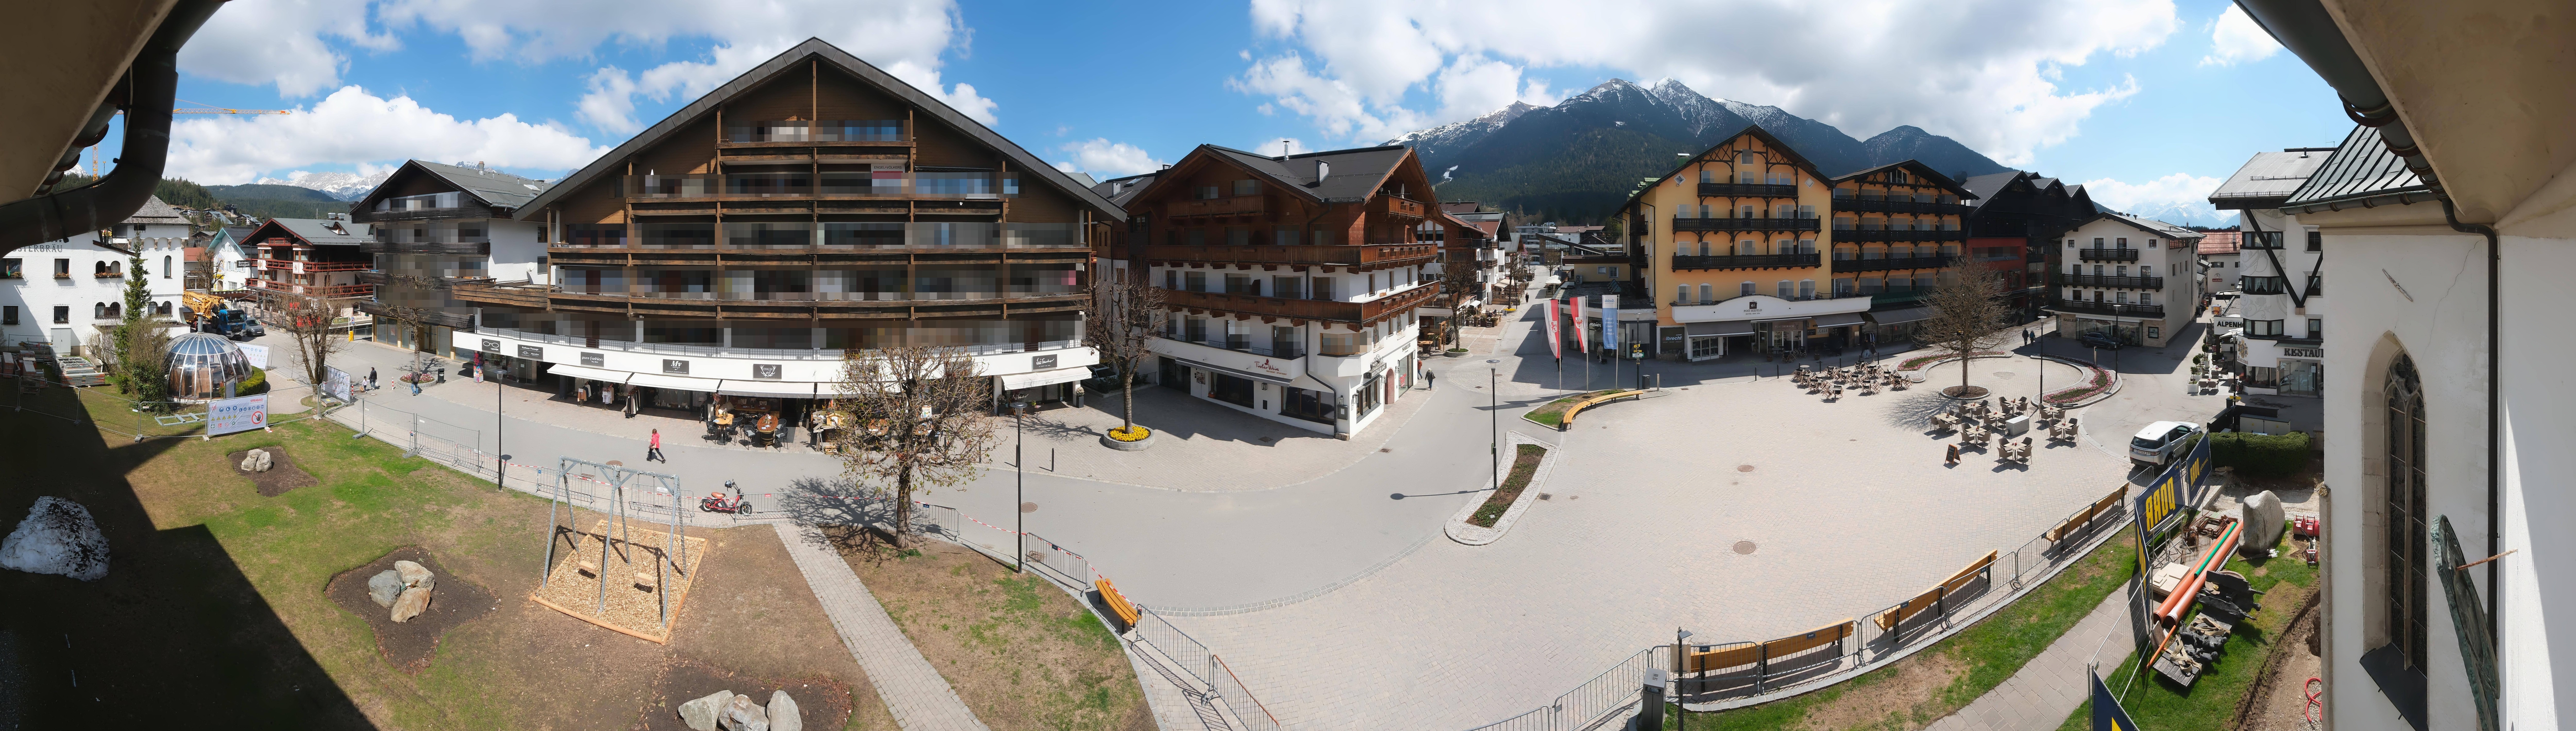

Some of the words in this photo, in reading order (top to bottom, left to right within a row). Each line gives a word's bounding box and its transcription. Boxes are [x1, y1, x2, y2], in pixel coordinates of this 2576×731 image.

[1402, 343, 1411, 352] SAILER
[671, 361, 682, 370] My
[1372, 364, 1386, 377] RESTAURANT
